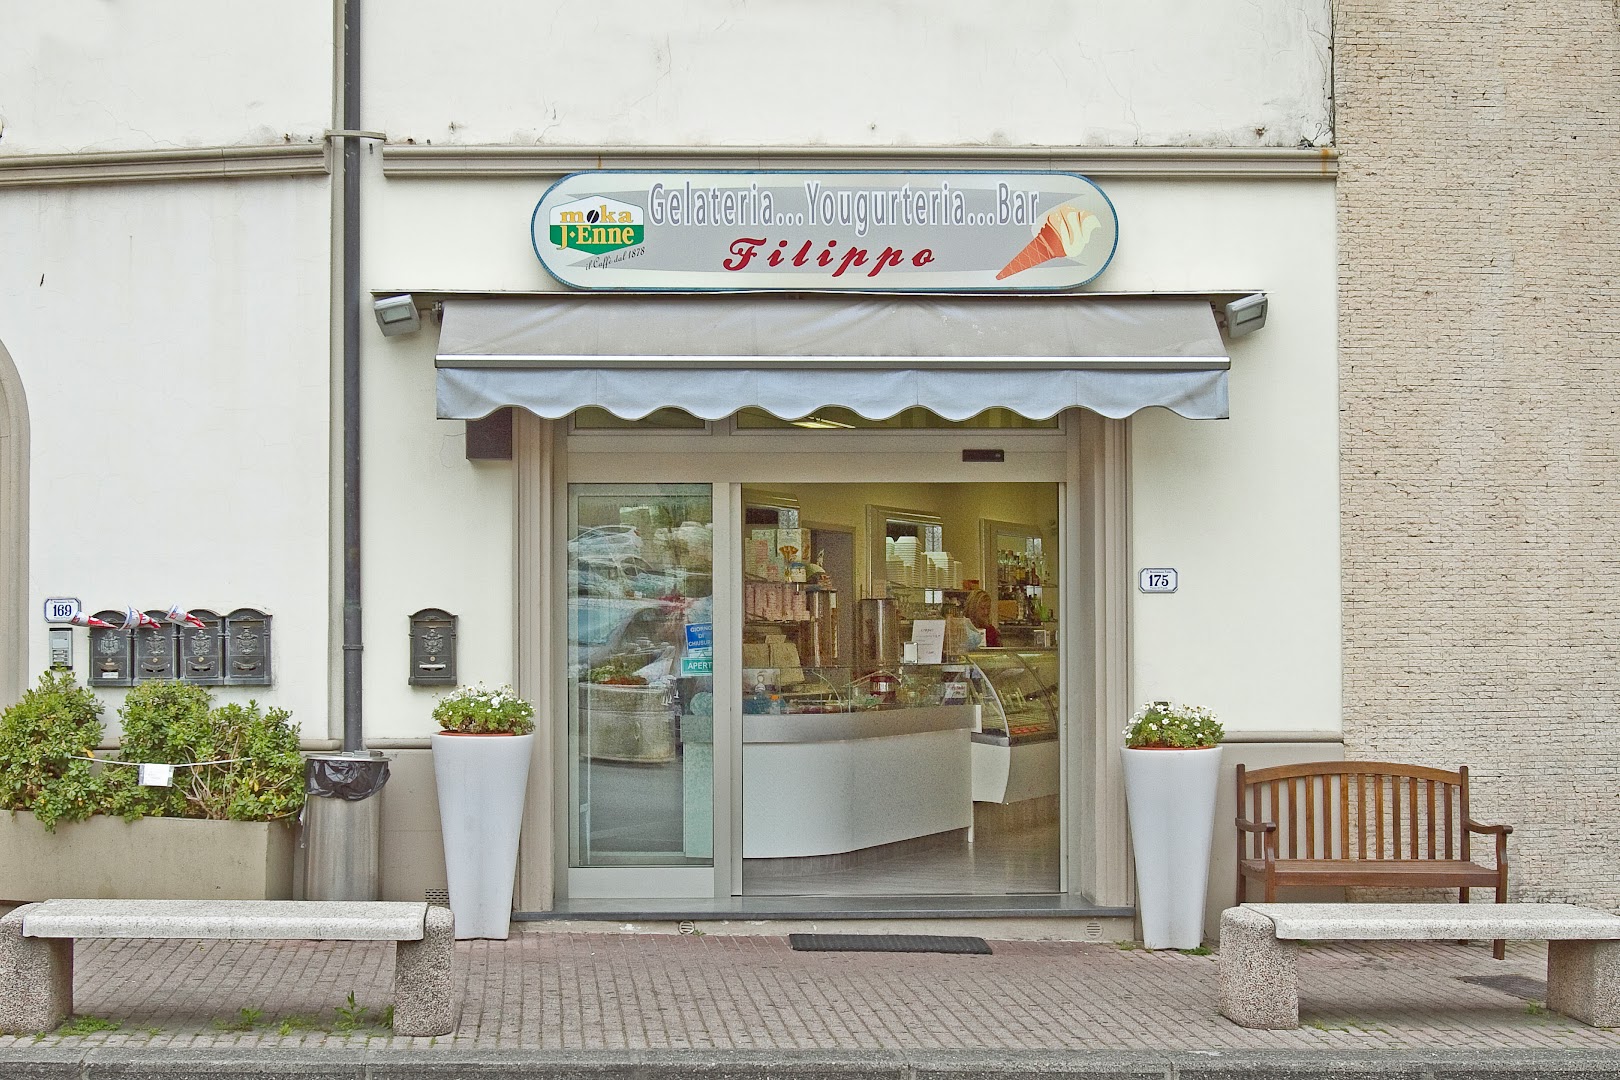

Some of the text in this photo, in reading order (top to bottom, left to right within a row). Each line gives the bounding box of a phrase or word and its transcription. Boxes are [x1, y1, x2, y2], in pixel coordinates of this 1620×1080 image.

[996, 181, 1040, 227] Bar
[560, 204, 634, 224] moka
[613, 251, 627, 263] dal
[628, 246, 646, 260] 1878
[722, 237, 935, 277] Filippo
[1149, 574, 1169, 586] 175
[53, 604, 72, 617] 169
